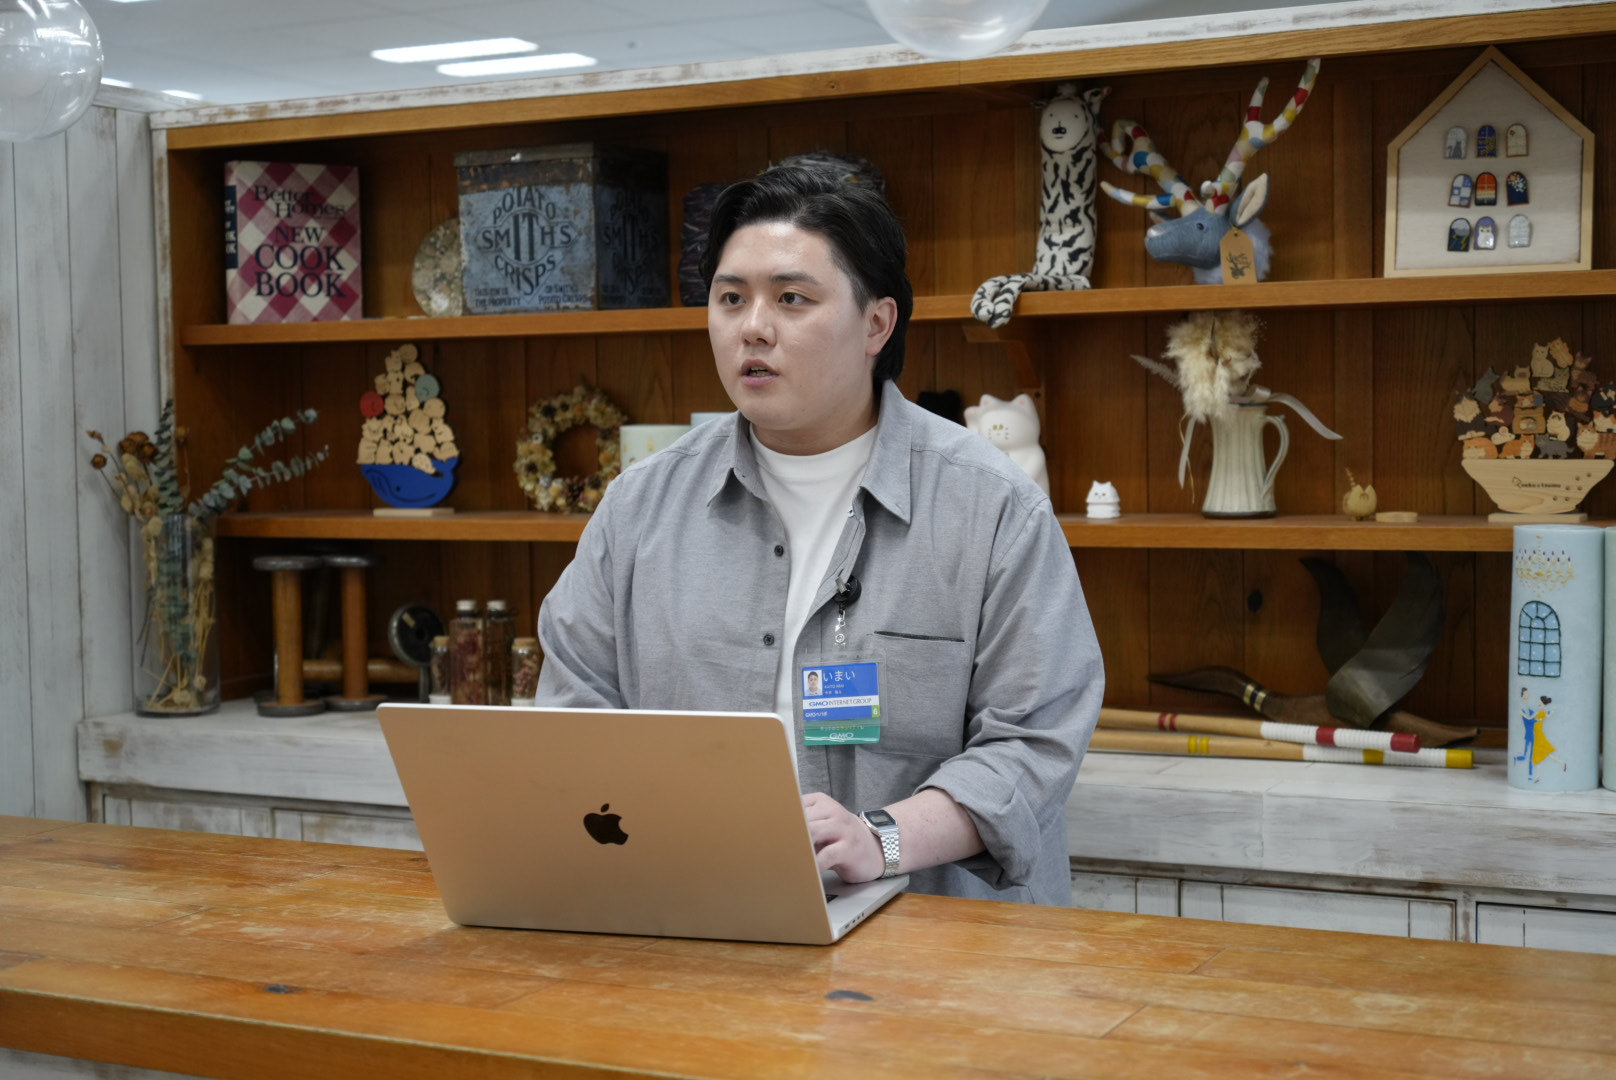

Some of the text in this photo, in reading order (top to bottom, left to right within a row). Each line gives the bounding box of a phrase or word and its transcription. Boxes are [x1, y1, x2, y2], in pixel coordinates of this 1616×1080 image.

[255, 185, 312, 202] Better
[274, 203, 346, 218] Homes
[492, 186, 557, 225] POTATO
[274, 226, 325, 243] NEW
[254, 243, 346, 271] COOK
[255, 271, 346, 298] BOOK
[494, 254, 556, 296] CRISPS
[823, 670, 856, 682] いまい
